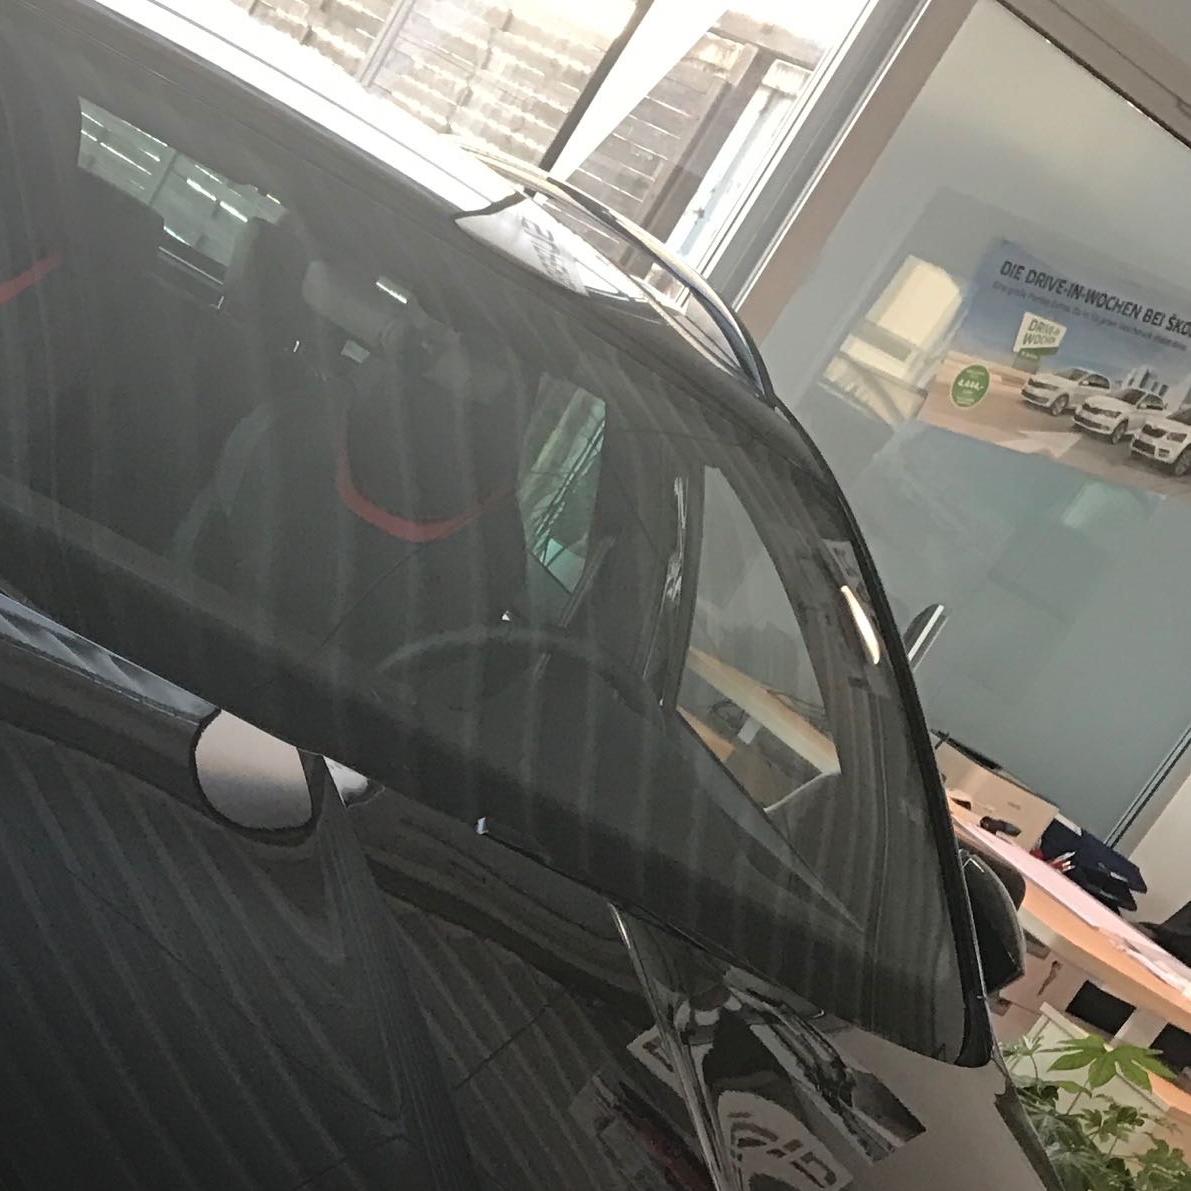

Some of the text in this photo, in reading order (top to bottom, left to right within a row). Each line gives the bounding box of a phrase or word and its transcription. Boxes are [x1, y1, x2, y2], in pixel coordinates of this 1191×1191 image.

[1000, 260, 1026, 281] DIE
[1025, 269, 1143, 320] DRIVE-IN-WOCHEN
[1142, 308, 1166, 327] BEI
[1165, 313, 1191, 338] ŠKO
